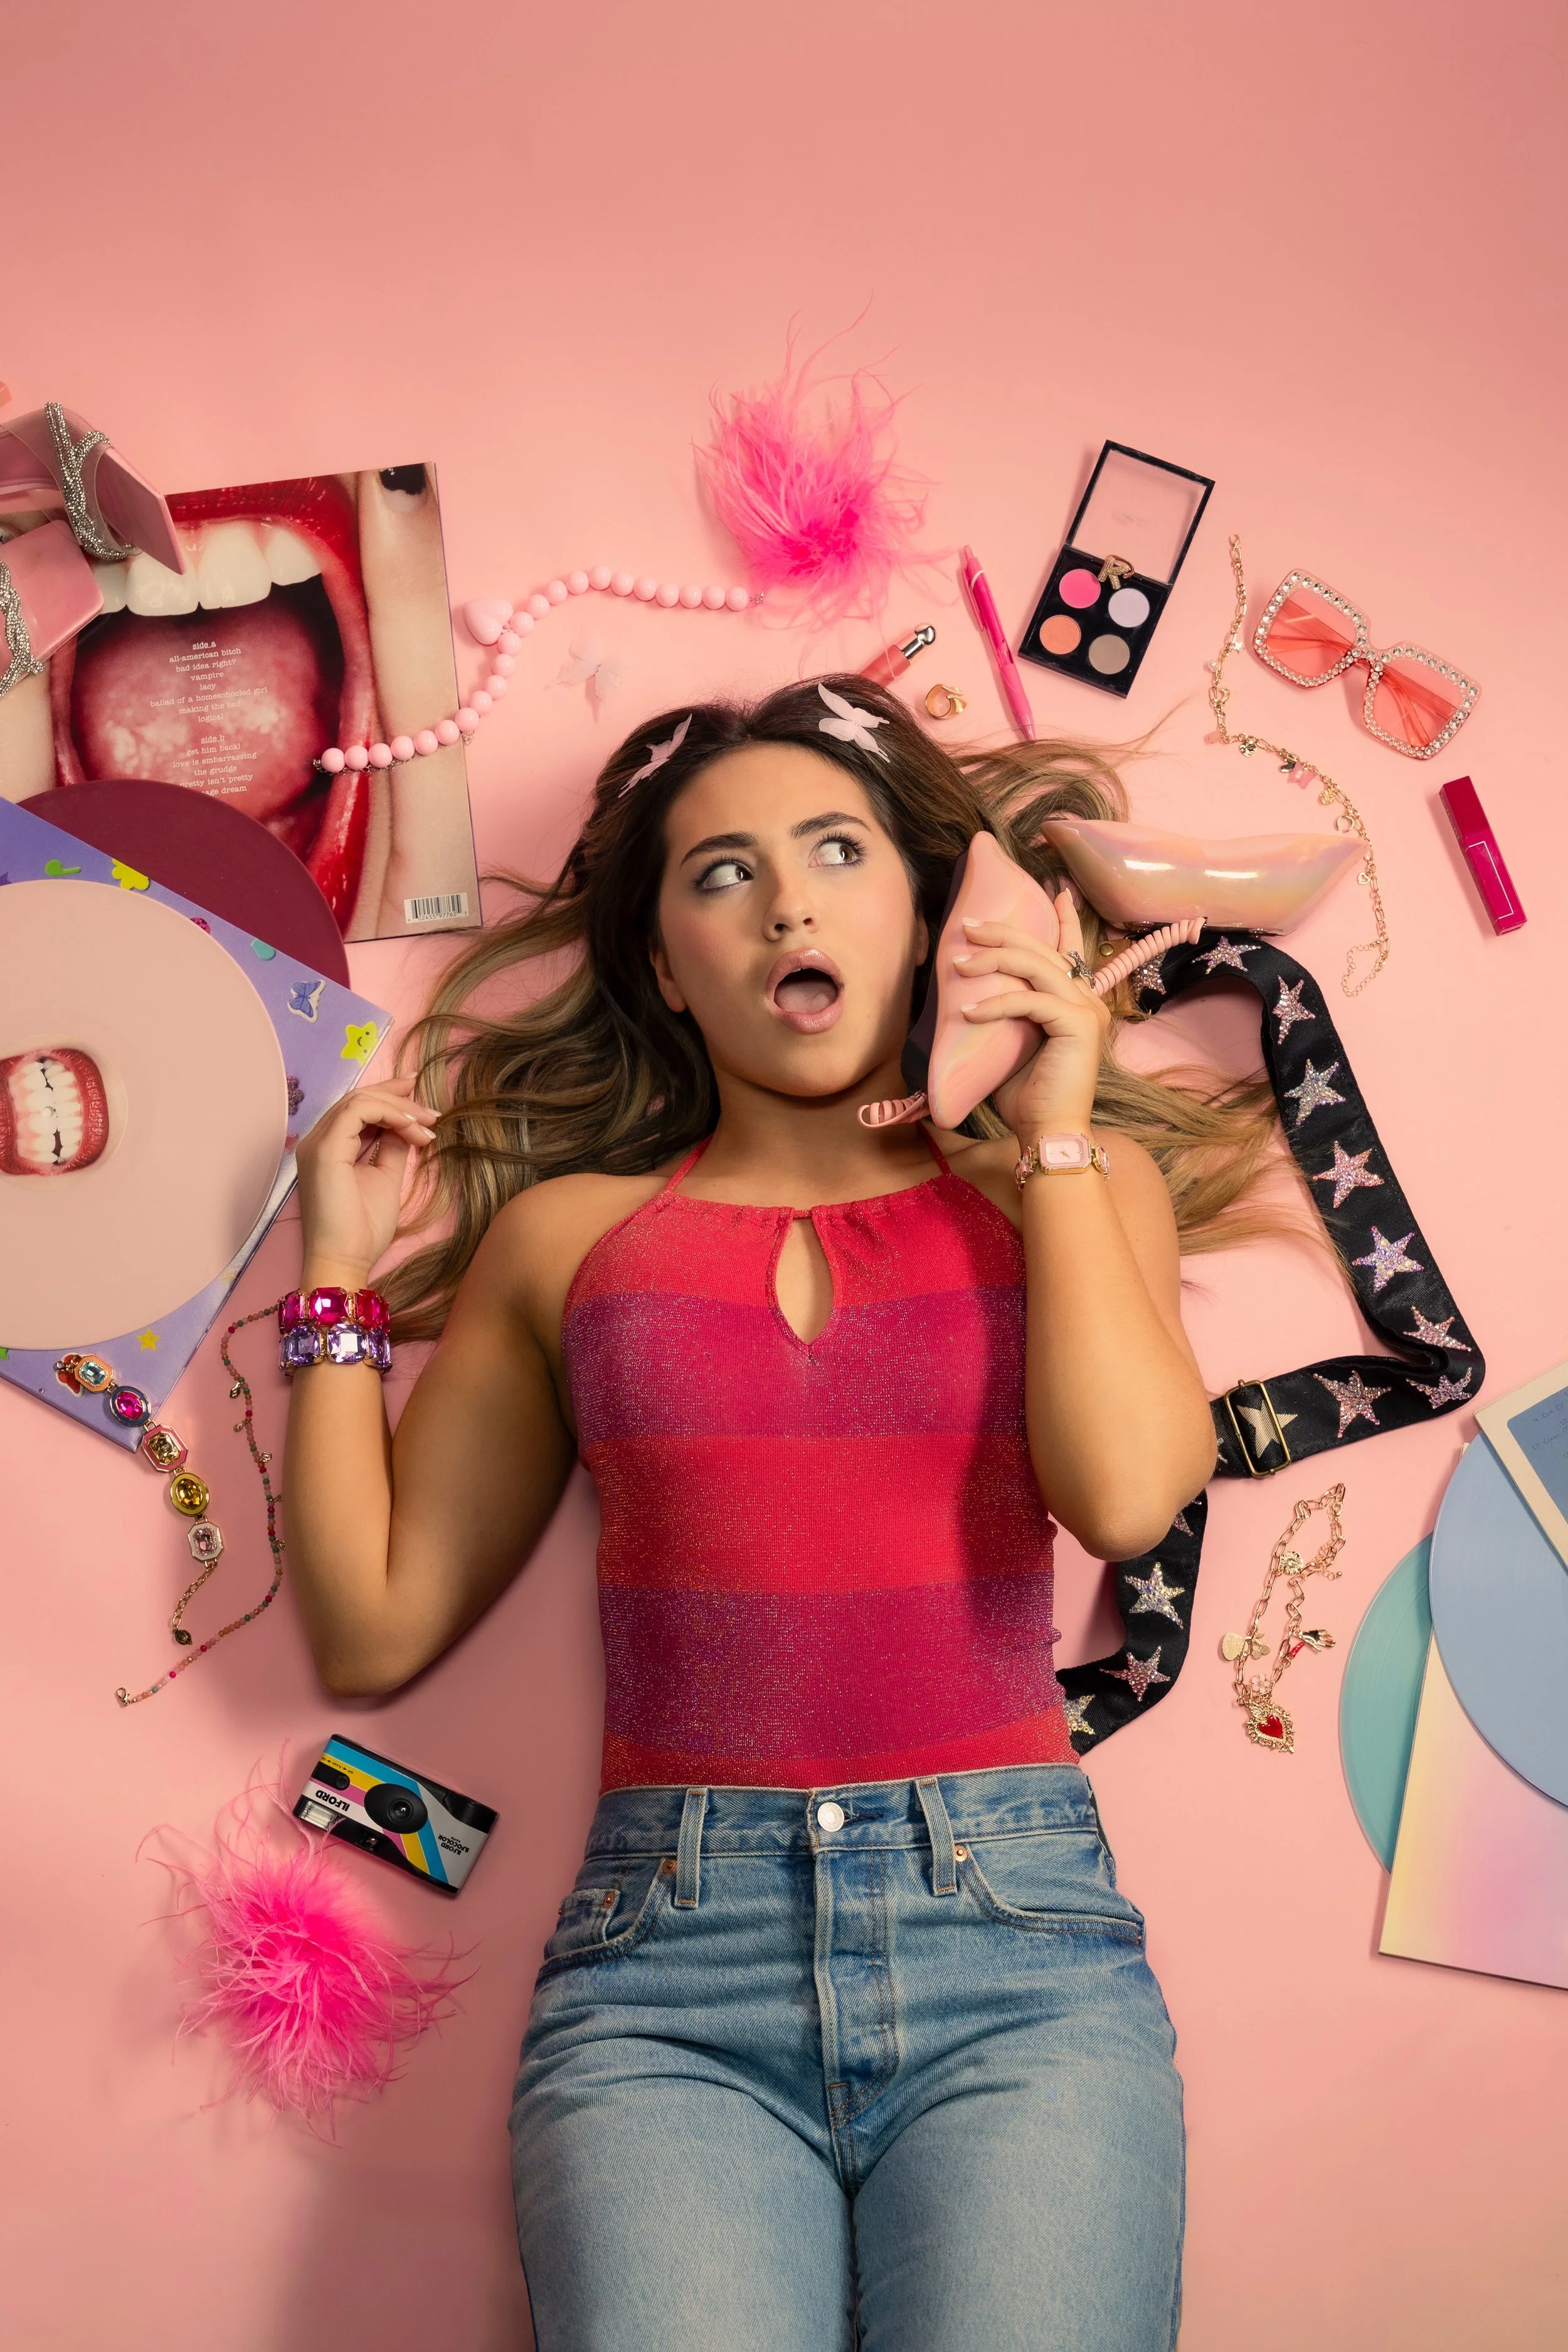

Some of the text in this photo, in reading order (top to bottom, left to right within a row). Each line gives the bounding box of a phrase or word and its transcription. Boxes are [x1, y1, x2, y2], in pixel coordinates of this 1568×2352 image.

[193, 642, 208, 650] side
[169, 648, 241, 663] all-american bitch
[193, 662, 209, 670] idea
[213, 659, 236, 669] right?
[191, 672, 224, 681] vampire
[151, 698, 174, 707] ballad
[196, 689, 250, 702] homeschooled
[254, 687, 268, 696] girl
[179, 704, 209, 714] making
[226, 701, 241, 709] bed
[198, 714, 223, 723] logical
[201, 736, 217, 744] side
[186, 749, 199, 757] get
[220, 743, 240, 751] back!
[201, 752, 257, 764] embarrassing
[210, 765, 237, 775] grudge
[208, 776, 226, 785] isn't
[228, 774, 253, 783] pretty
[221, 786, 246, 794] dream
[315, 1789, 350, 1812] ILFORD
[438, 1834, 470, 1853] ILFOCOLOR
[441, 1842, 462, 1855] ILFORD
